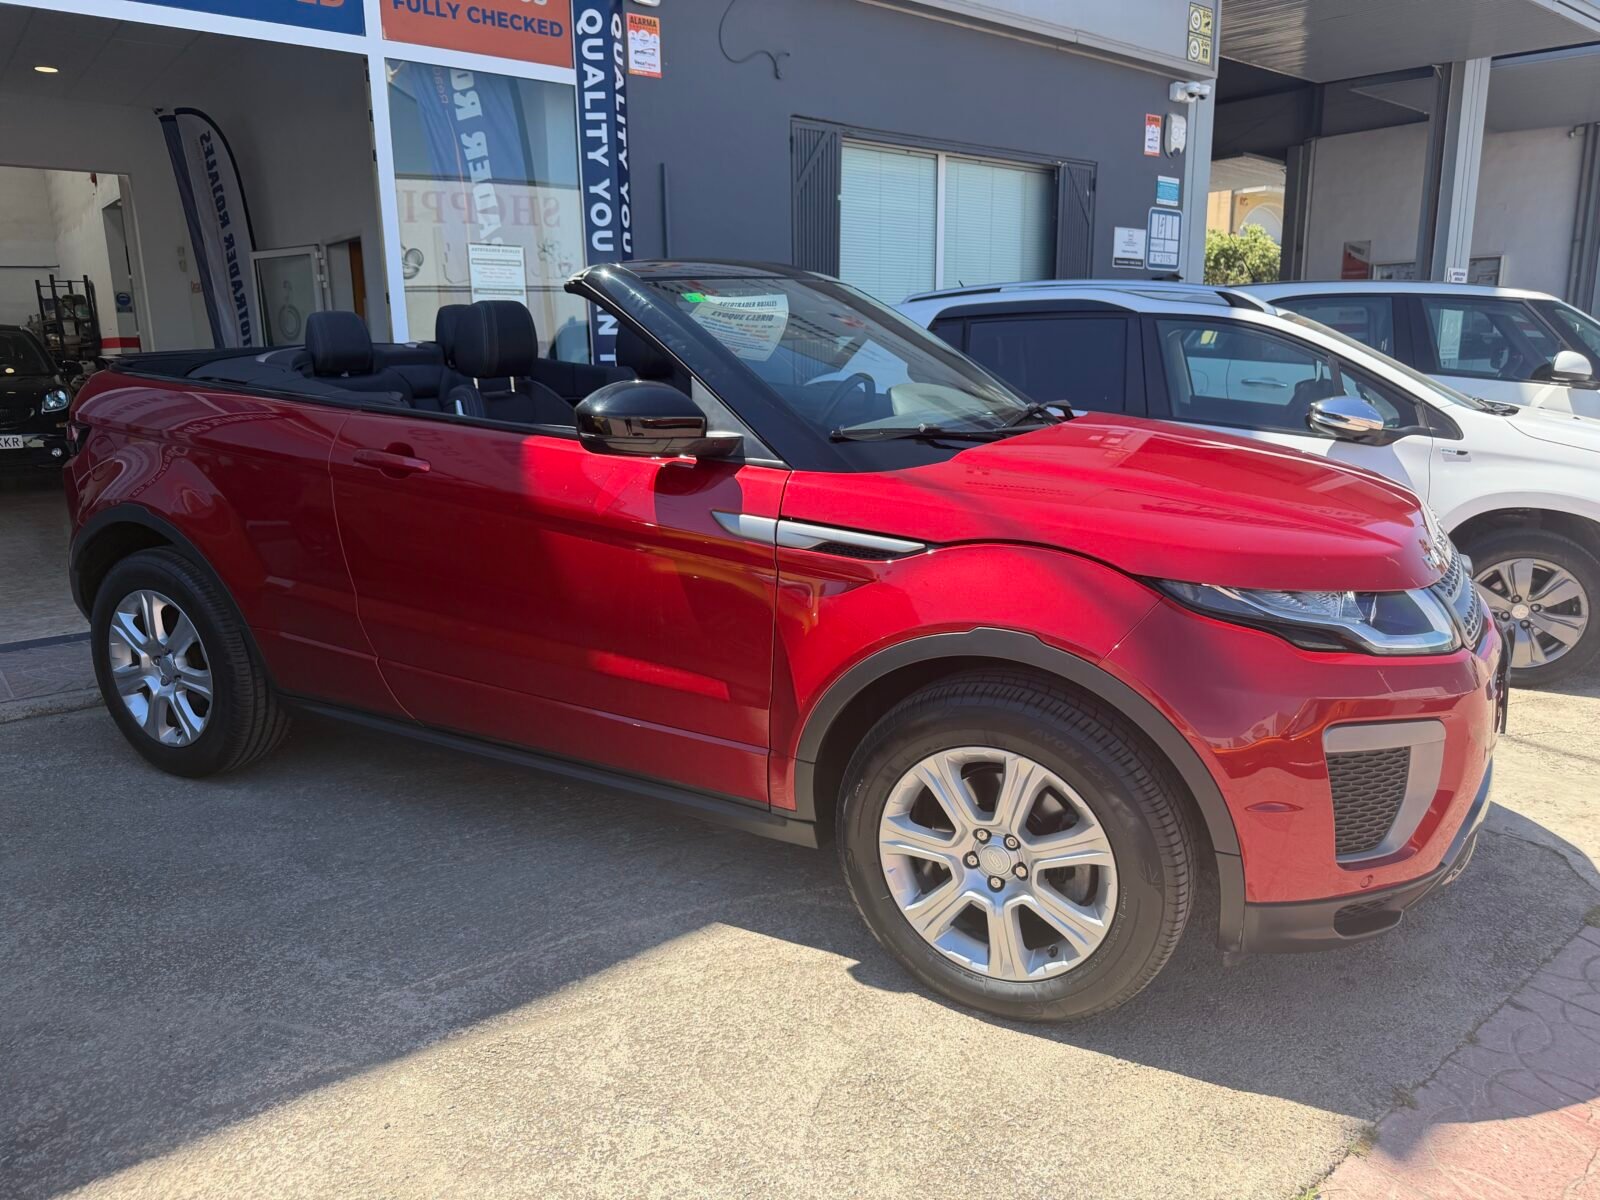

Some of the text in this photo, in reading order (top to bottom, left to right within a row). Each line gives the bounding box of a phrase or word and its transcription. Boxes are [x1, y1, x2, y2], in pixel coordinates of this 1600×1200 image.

[393, 0, 563, 38] FULLY CHECKED
[629, 16, 657, 28] ALARMA
[576, 8, 610, 168] QUALITY
[610, 12, 632, 254] QUALITY YOU
[588, 177, 615, 252] YOU
[711, 310, 744, 321] EVOQUE
